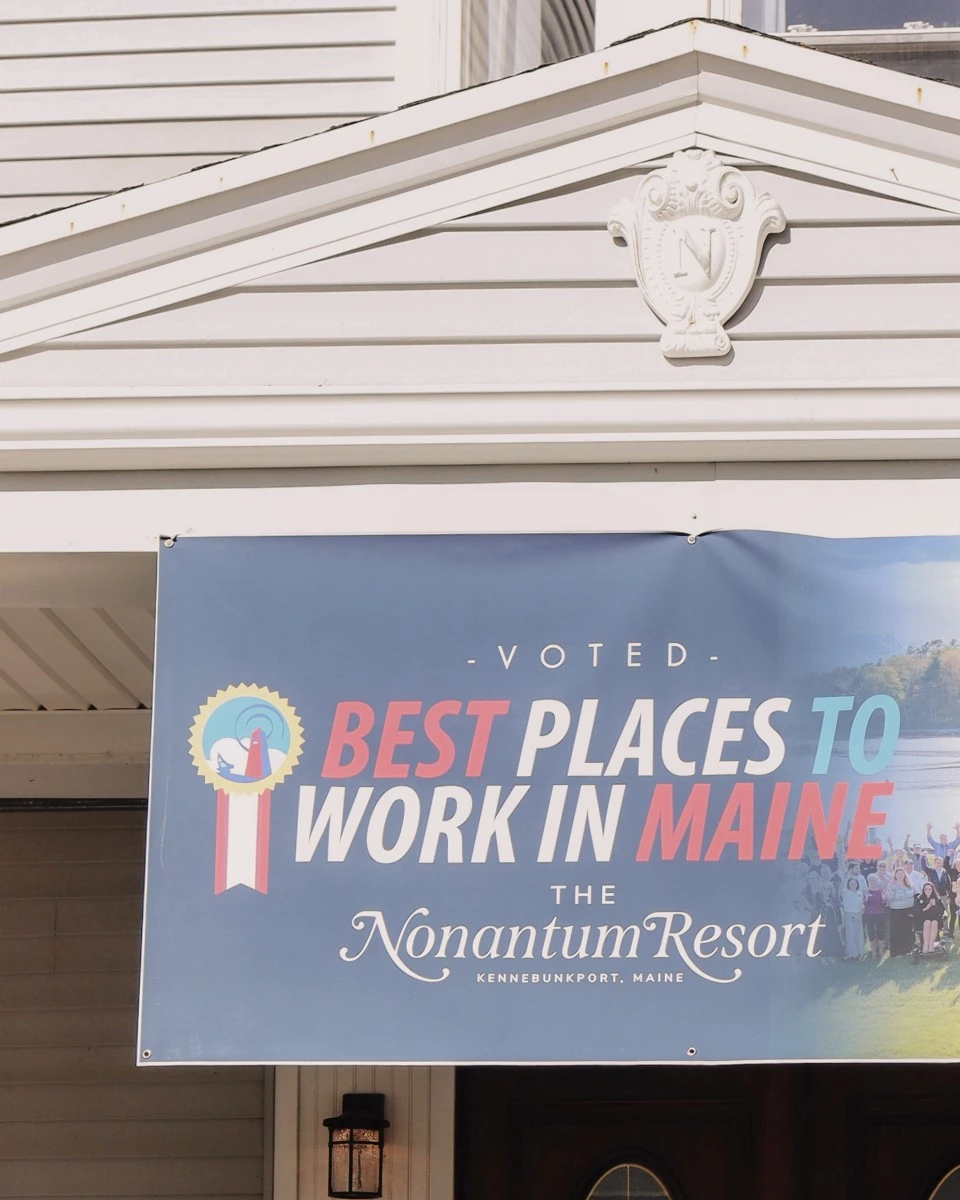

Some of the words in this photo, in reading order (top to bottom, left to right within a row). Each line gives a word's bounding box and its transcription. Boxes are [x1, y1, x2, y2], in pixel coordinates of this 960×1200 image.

[671, 226, 717, 281] N
[321, 700, 511, 779] BEST
[516, 697, 792, 778] PLACES
[811, 694, 901, 776] TO
[295, 784, 532, 864] WORK
[536, 783, 626, 863] IN
[635, 781, 895, 863] MAINE
[550, 884, 616, 906] THE
[339, 907, 642, 983] Nonantum
[642, 911, 827, 984] Resort
[476, 972, 625, 984] KENNEBUNKPORT,
[632, 972, 685, 983] MAINE
